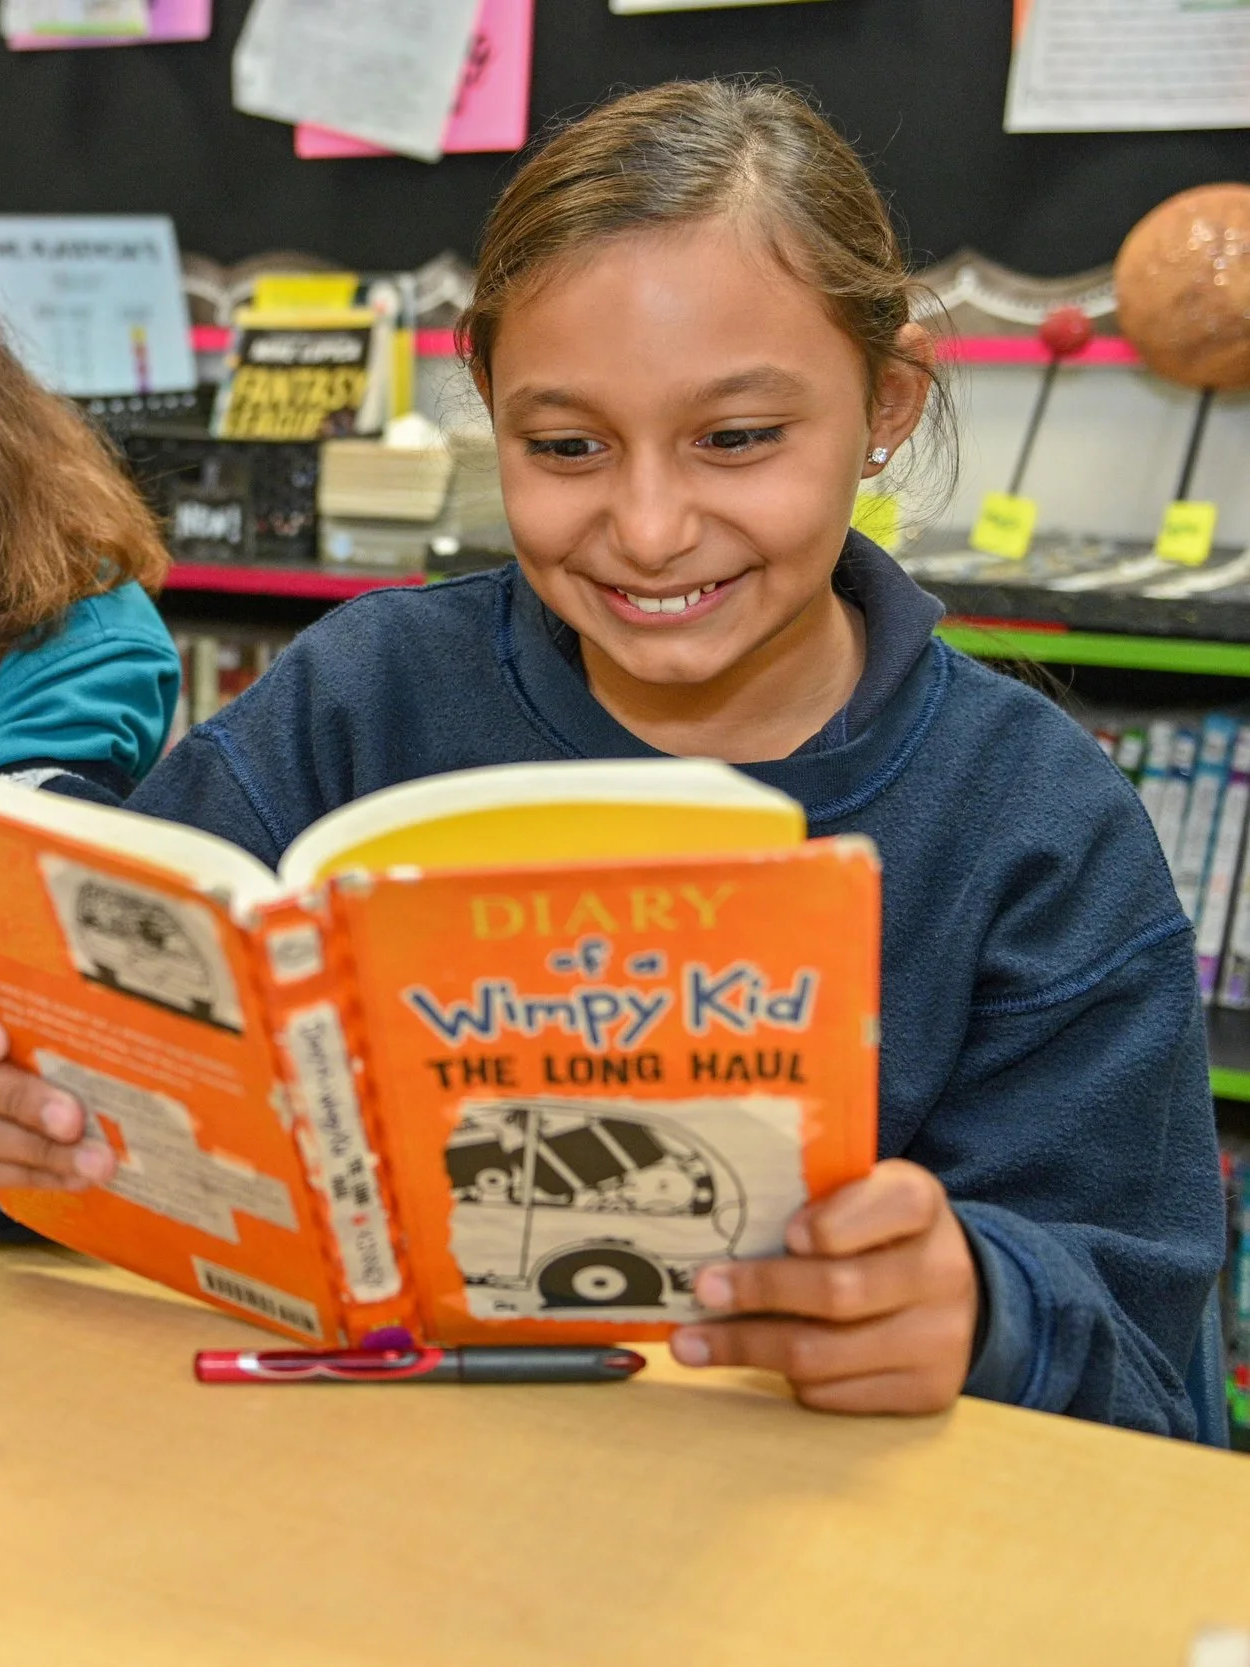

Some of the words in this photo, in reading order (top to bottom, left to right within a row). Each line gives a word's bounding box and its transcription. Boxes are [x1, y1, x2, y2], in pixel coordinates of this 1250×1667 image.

[467, 882, 738, 939] DIARY
[547, 935, 612, 978] of
[403, 978, 674, 1050] Wimpy
[683, 961, 819, 1036] Kid
[429, 1055, 517, 1090] THE
[543, 1052, 665, 1087] LONG
[690, 1050, 809, 1084] HAUL
